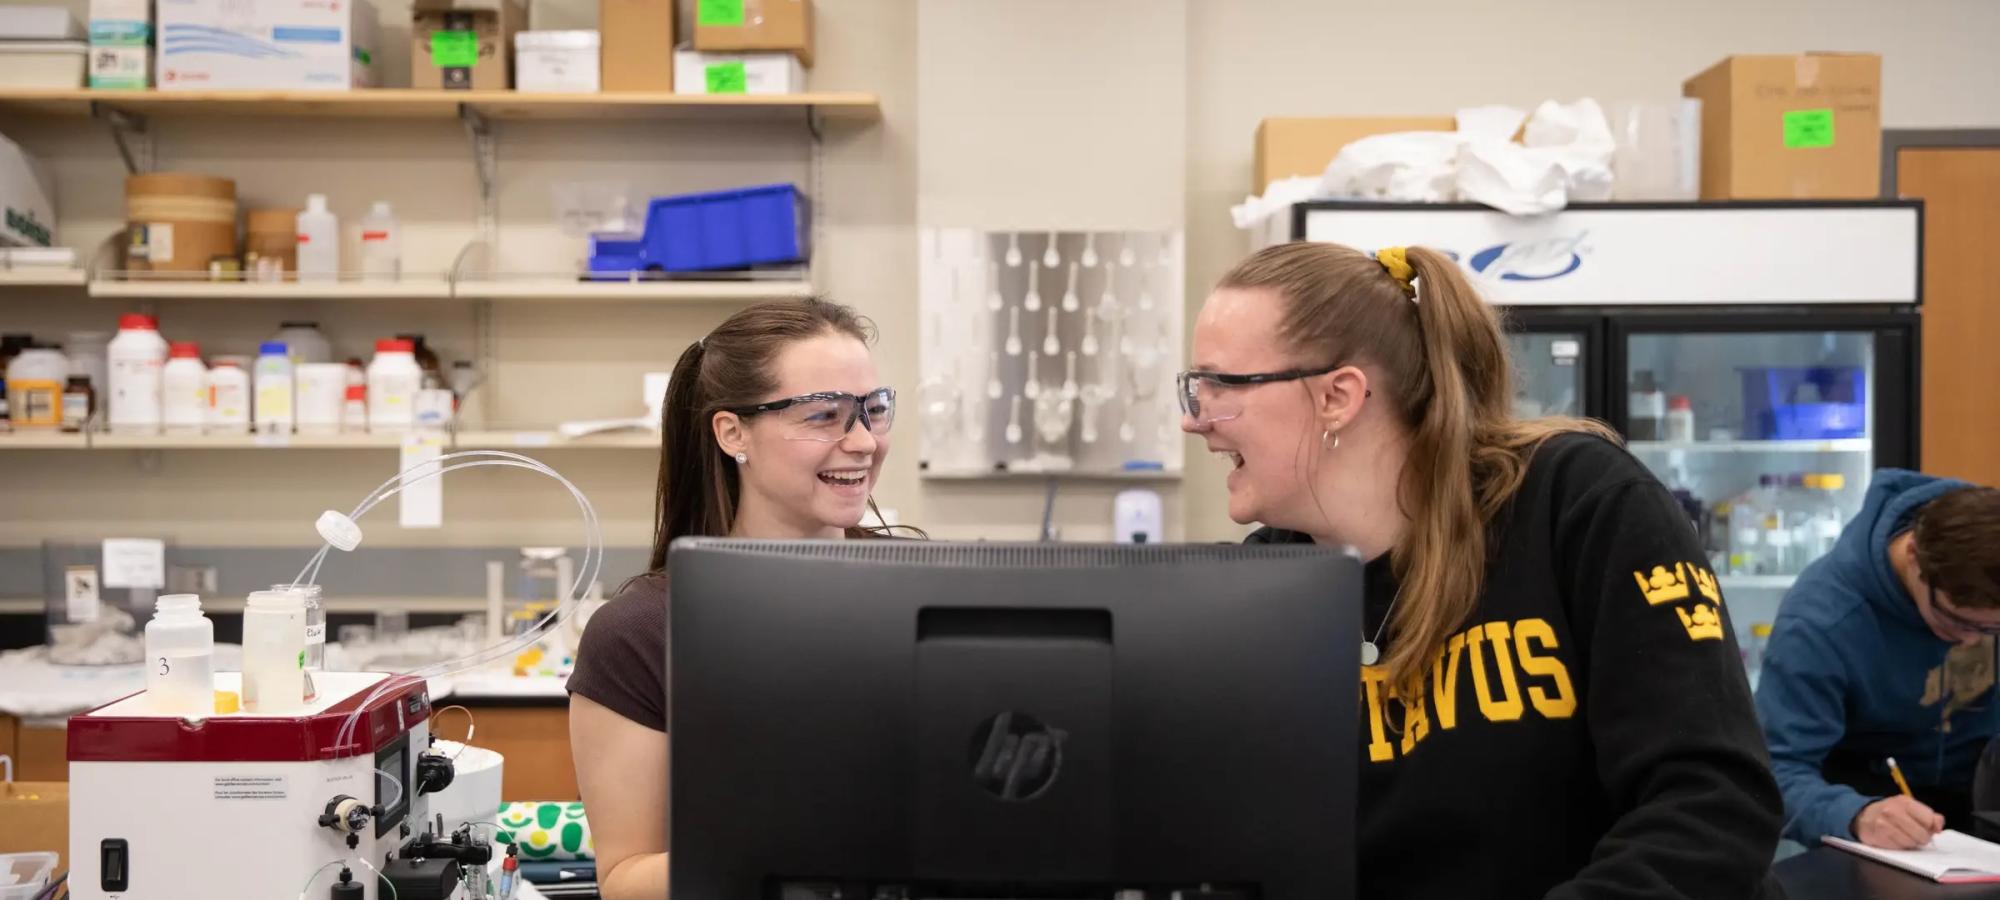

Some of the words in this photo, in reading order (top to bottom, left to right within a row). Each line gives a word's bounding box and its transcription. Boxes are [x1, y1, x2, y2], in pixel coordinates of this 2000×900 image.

[158, 657, 170, 676] 3
[1360, 618, 1577, 763] TAVUS
[973, 710, 1056, 801] hp
